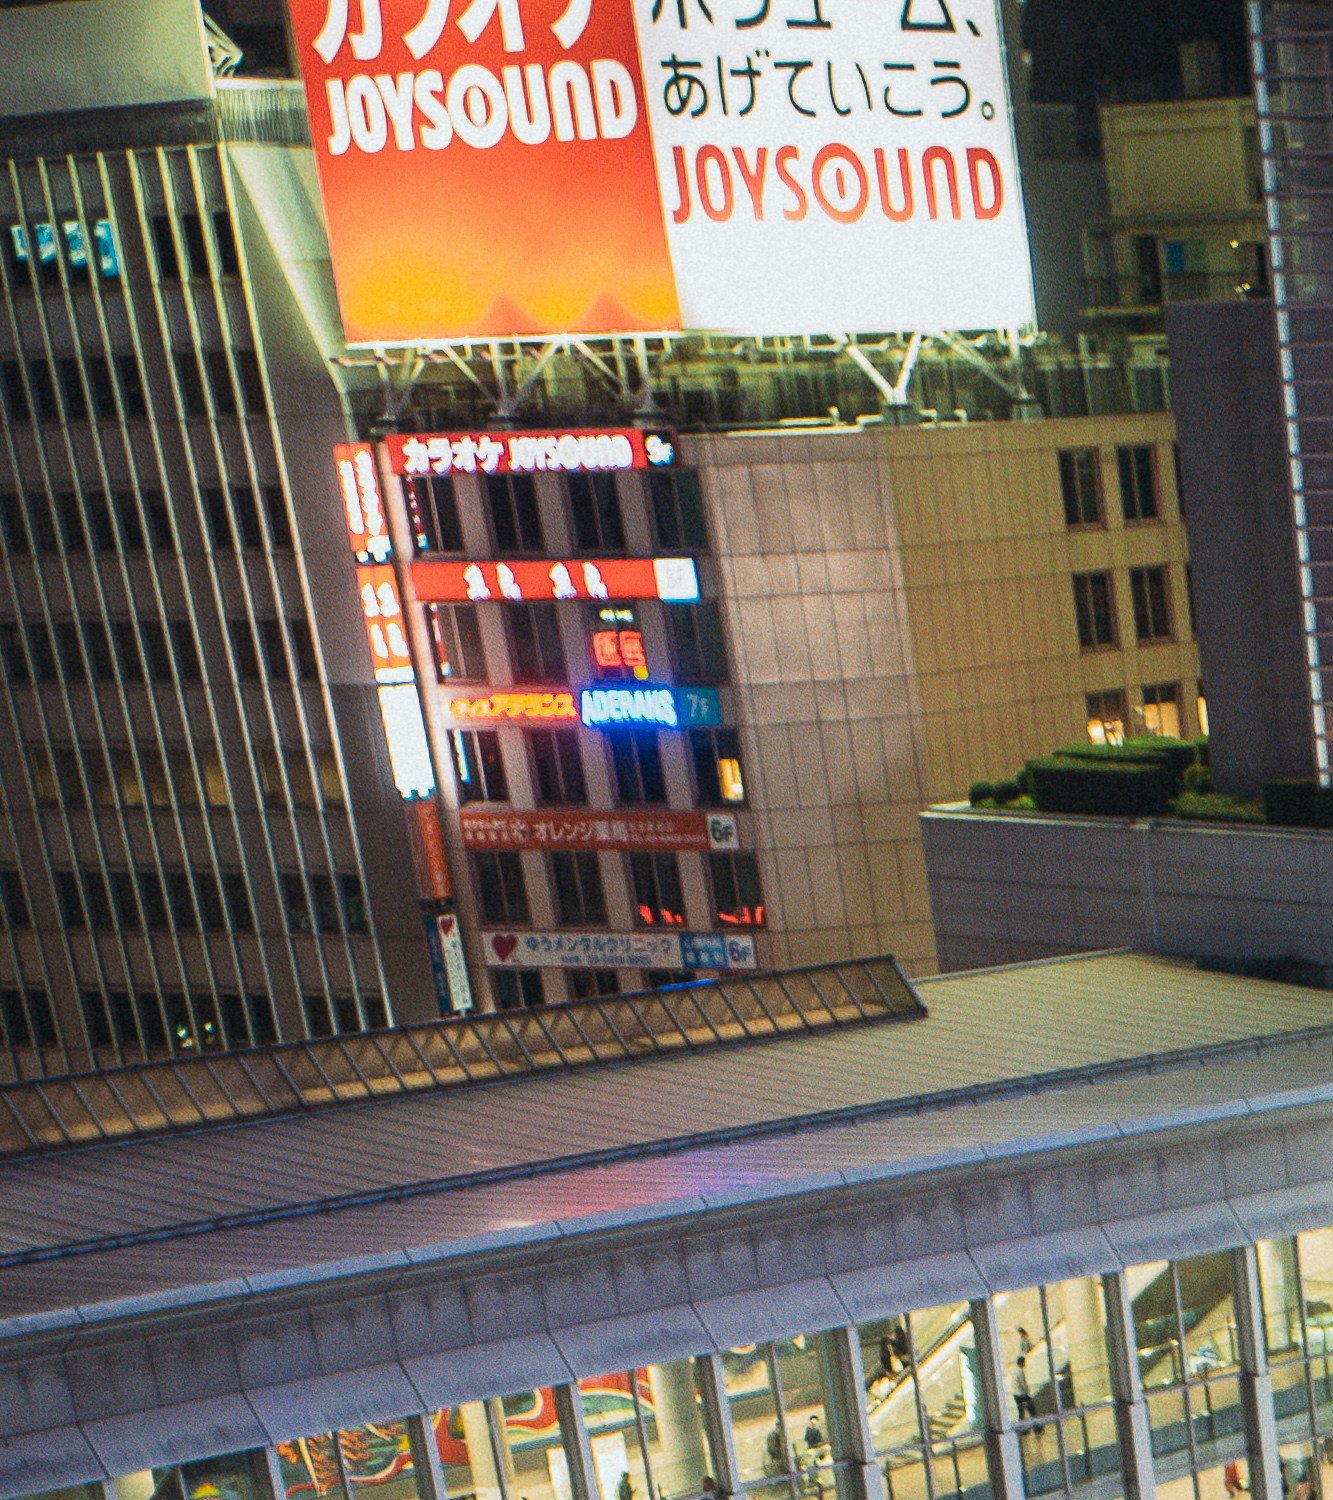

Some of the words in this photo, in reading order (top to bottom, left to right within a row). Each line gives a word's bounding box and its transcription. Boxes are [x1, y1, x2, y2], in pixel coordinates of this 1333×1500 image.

[325, 59, 638, 156] JOYSOUND
[661, 48, 994, 120] あげていこう。
[672, 143, 1004, 224] JOYSOUND
[402, 436, 504, 474] カラオケ
[508, 434, 634, 473] JOYSOUND
[709, 819, 734, 843] 6F
